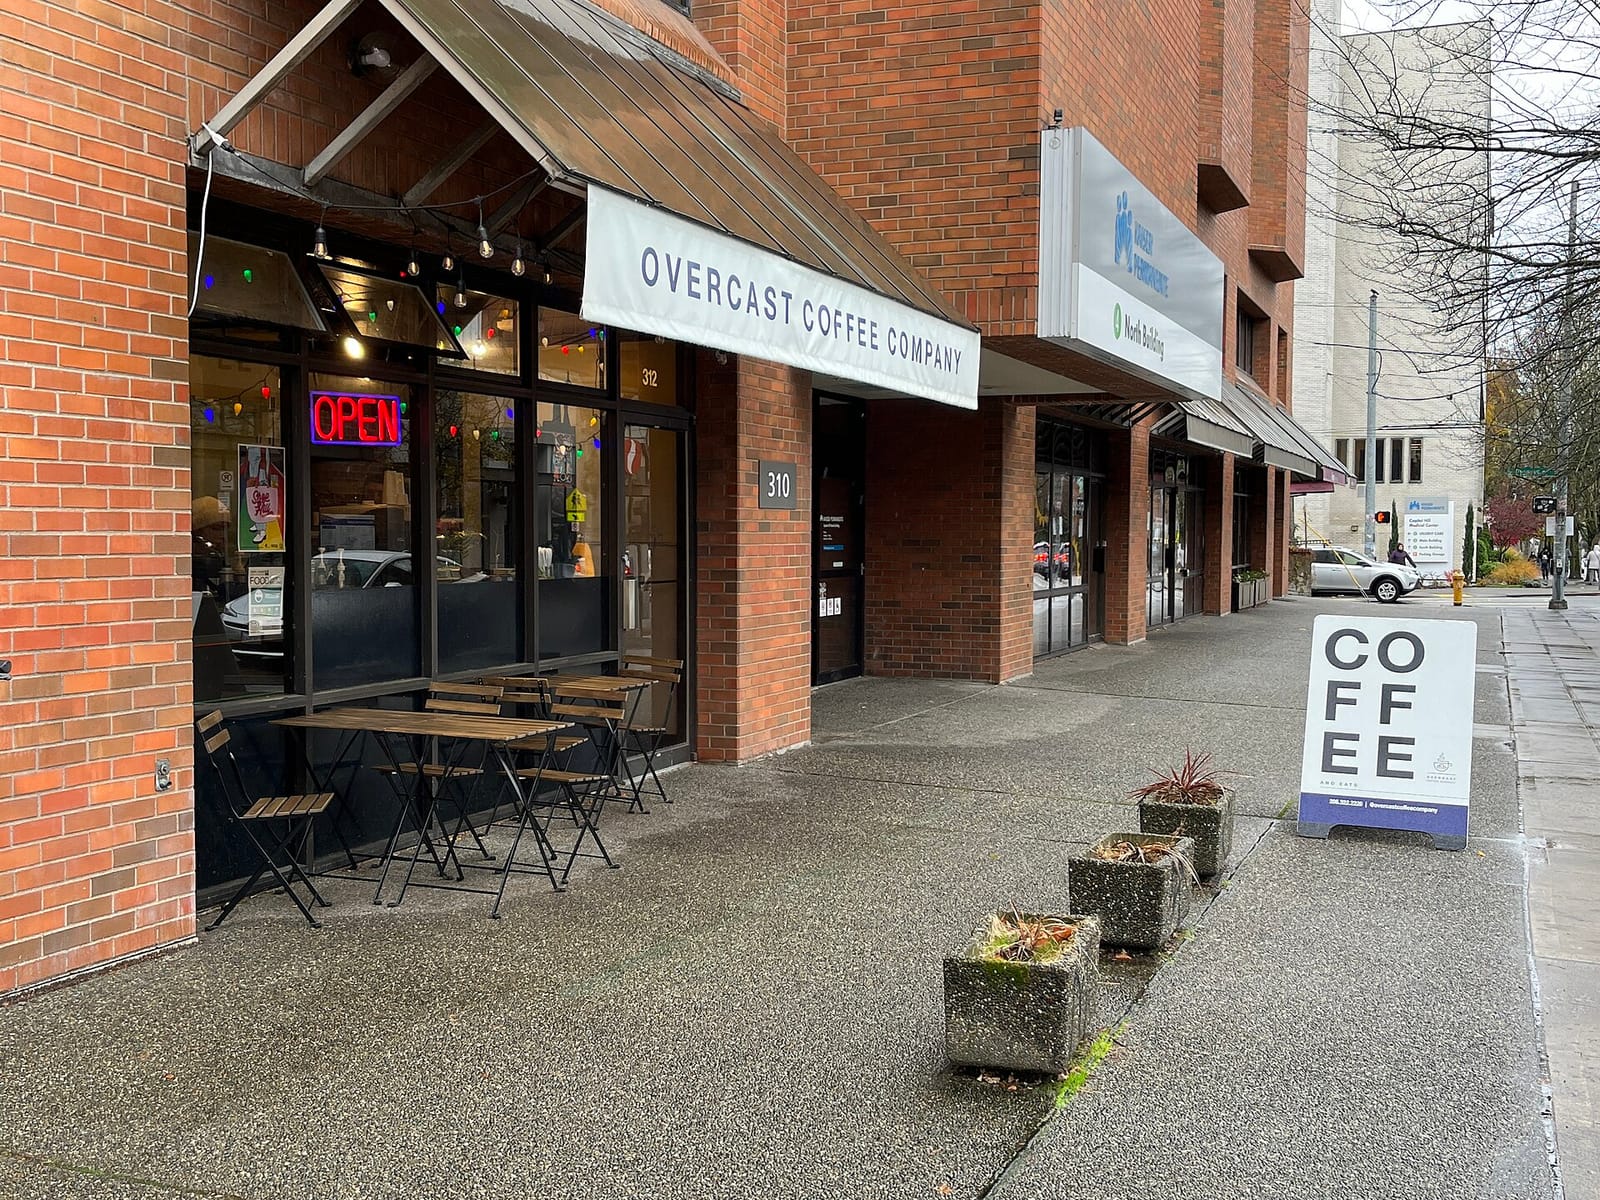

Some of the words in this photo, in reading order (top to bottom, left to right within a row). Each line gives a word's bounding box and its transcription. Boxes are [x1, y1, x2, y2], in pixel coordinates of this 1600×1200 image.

[641, 246, 793, 325] OVERCAST
[802, 299, 879, 350] COFFEE
[887, 326, 962, 375] COMPANY
[1124, 313, 1142, 345] North
[1142, 323, 1164, 362] Building
[642, 368, 658, 387] 312
[314, 396, 398, 441] OPEN
[767, 471, 790, 498] 310
